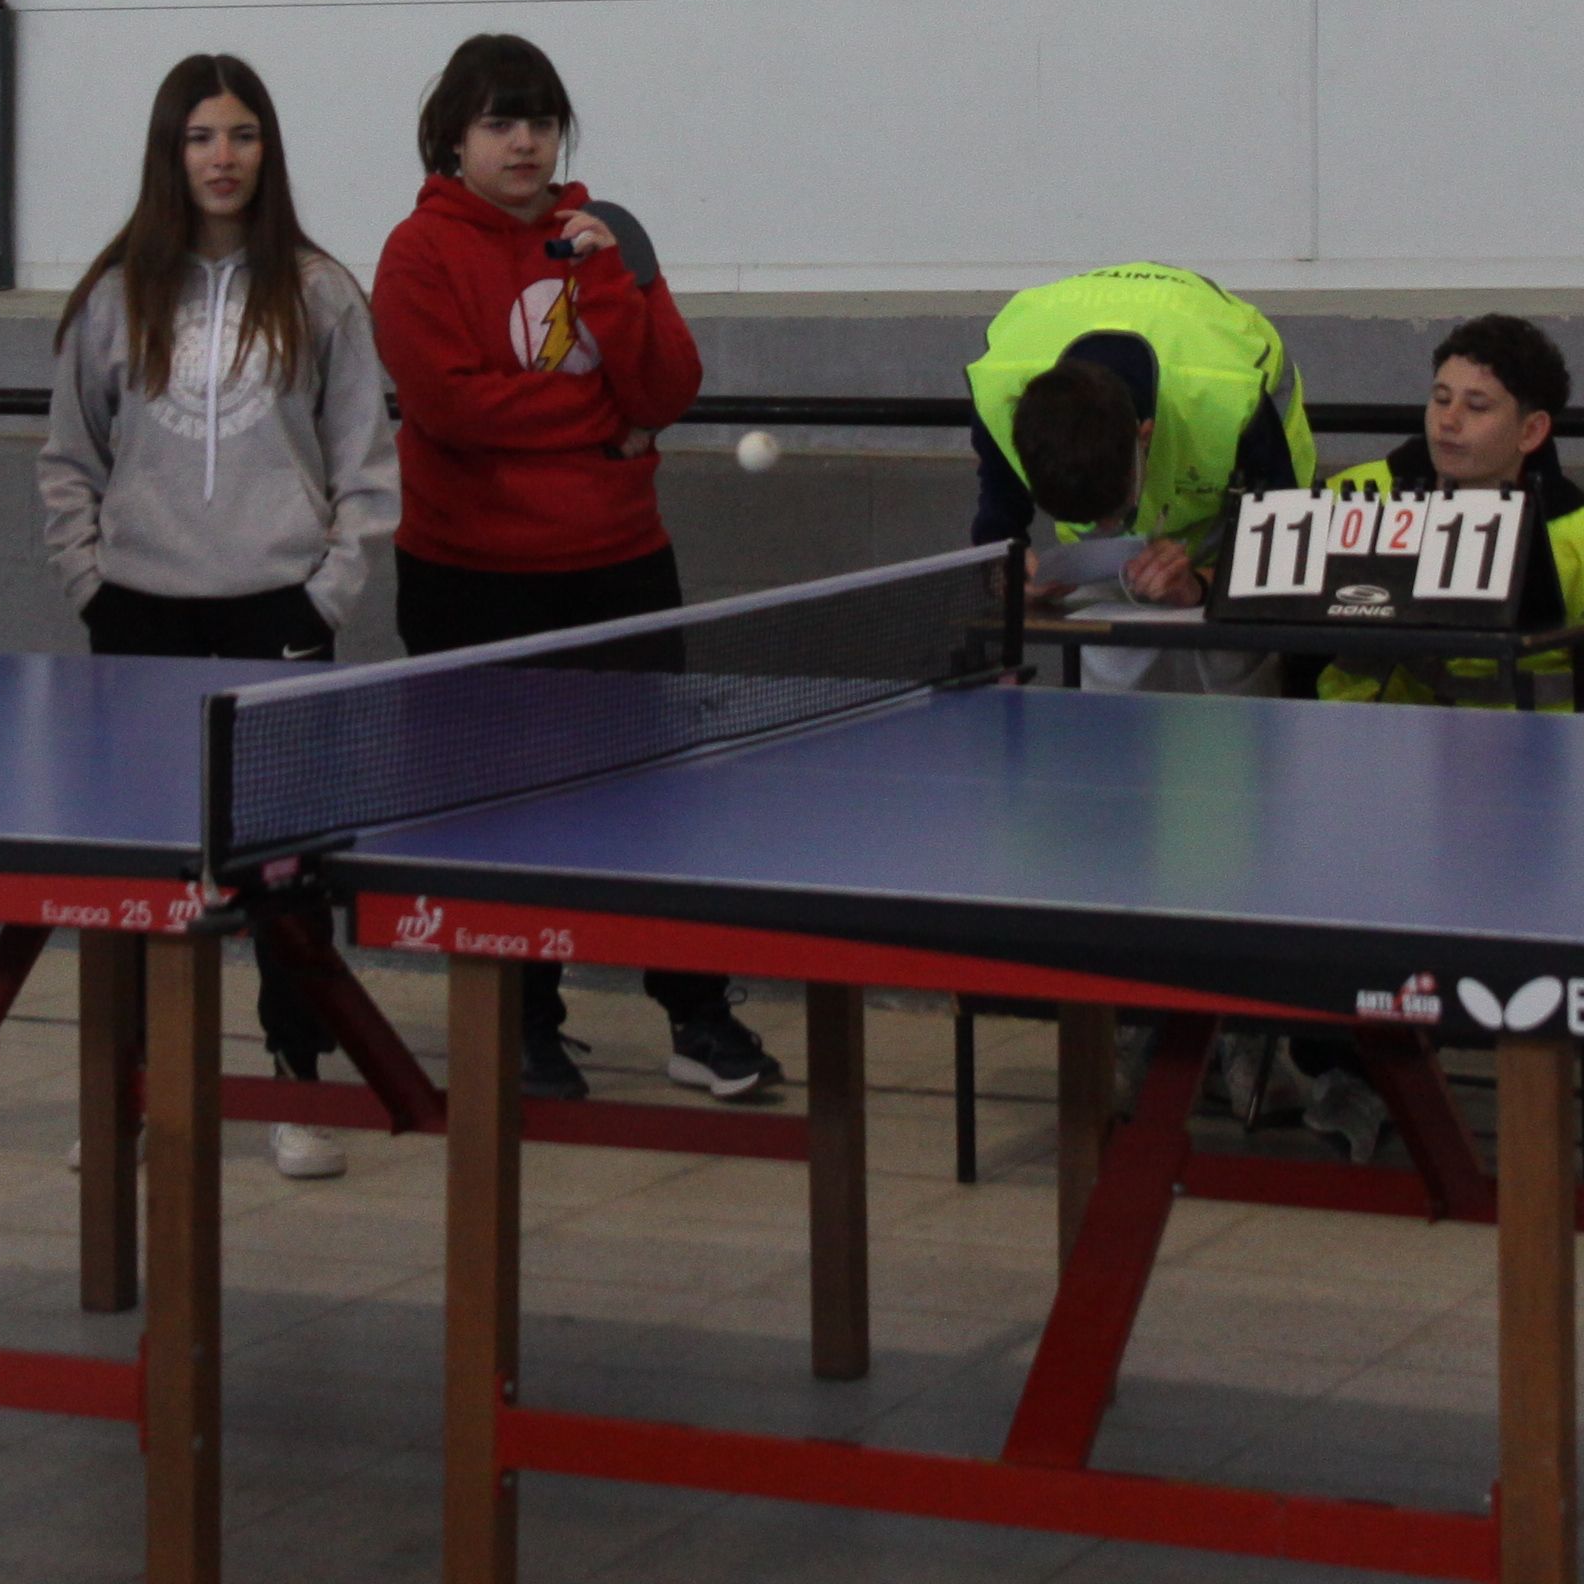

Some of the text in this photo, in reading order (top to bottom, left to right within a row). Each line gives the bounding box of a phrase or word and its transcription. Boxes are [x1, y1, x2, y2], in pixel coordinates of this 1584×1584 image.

[1249, 509, 1503, 591] 11 0 2 11
[1326, 604, 1395, 618] DONIC
[41, 898, 111, 928] Europa
[120, 899, 153, 929] 25
[455, 927, 575, 959] Europa 25
